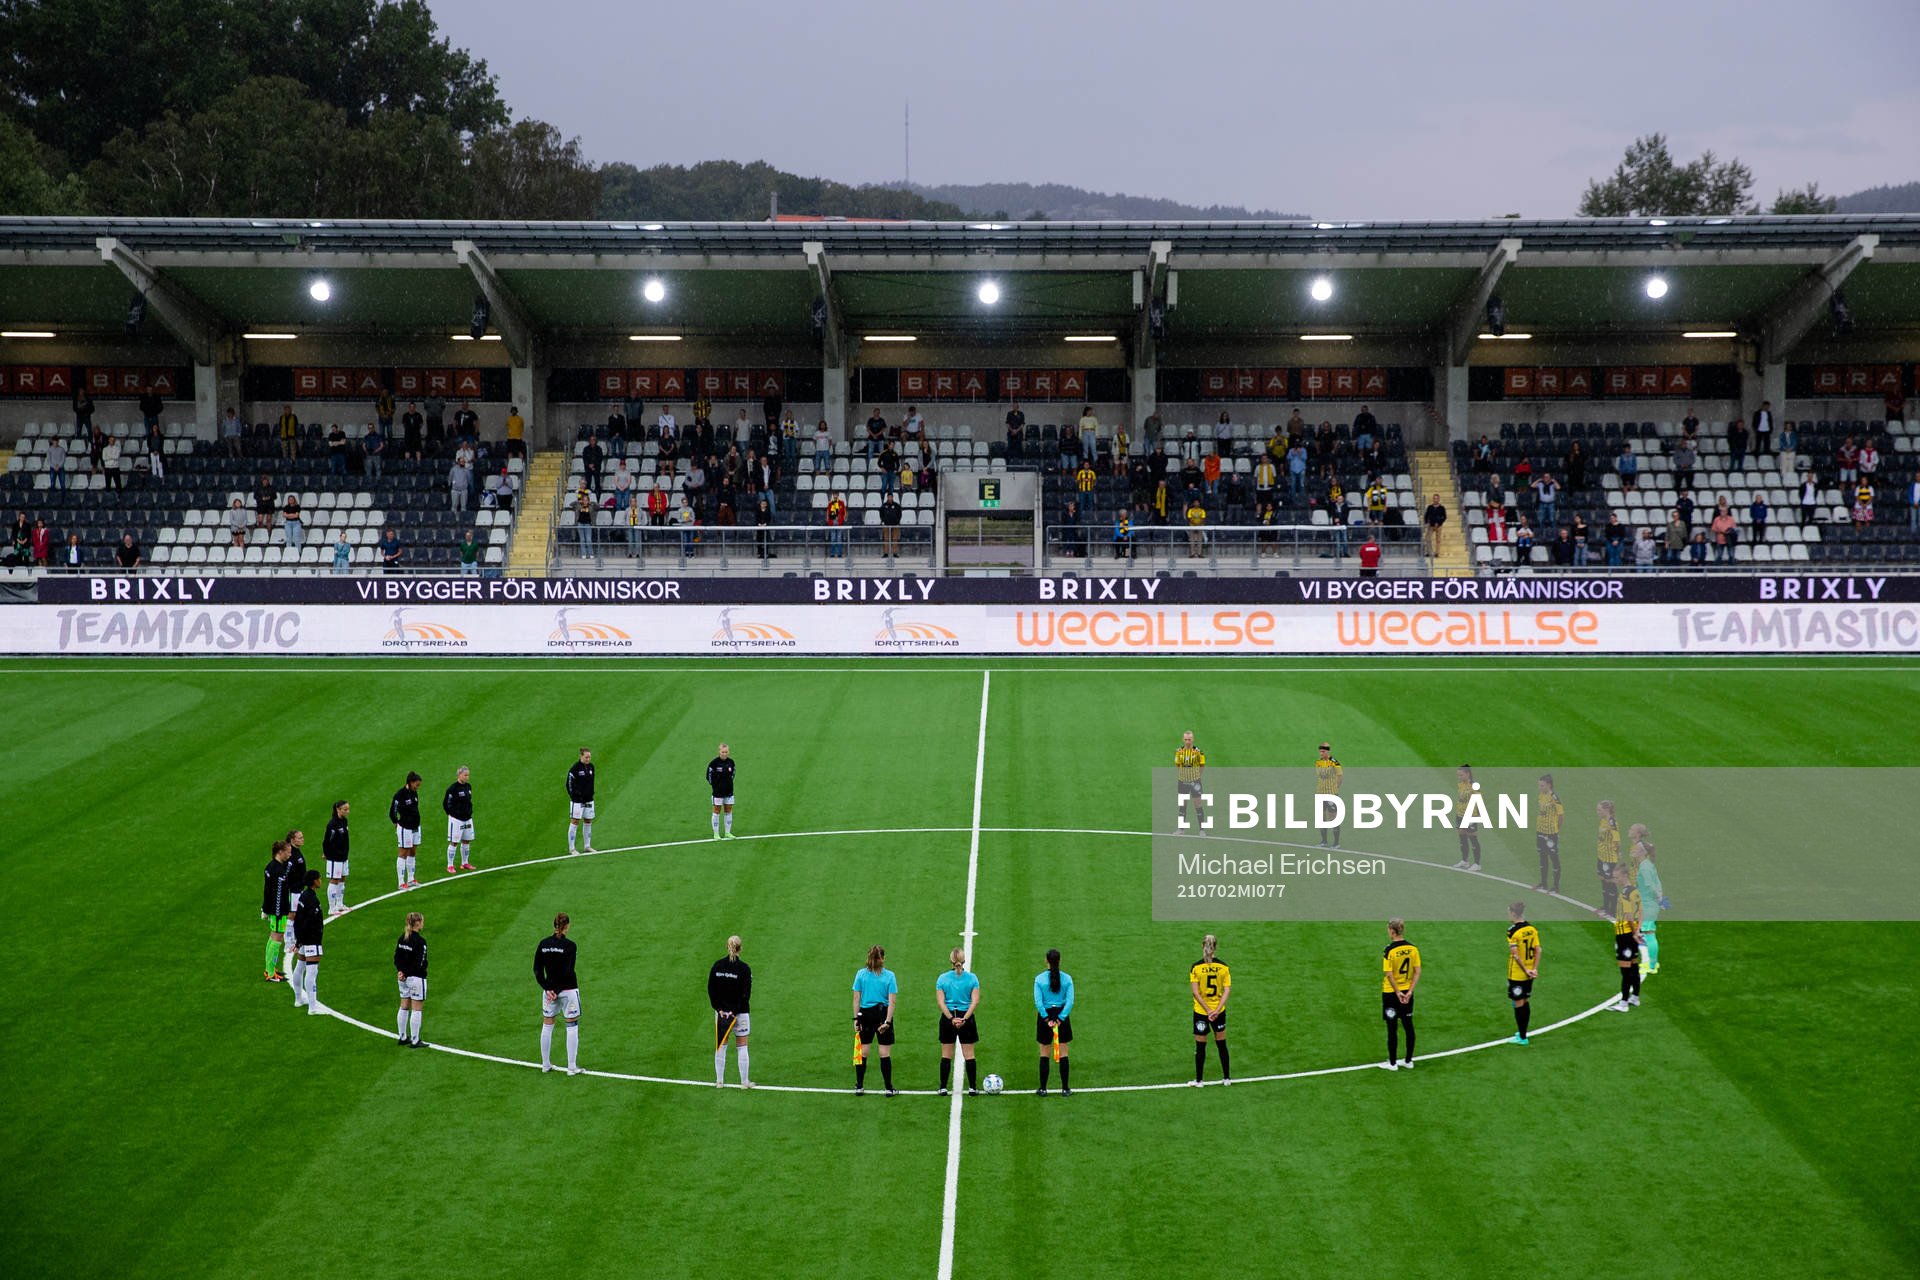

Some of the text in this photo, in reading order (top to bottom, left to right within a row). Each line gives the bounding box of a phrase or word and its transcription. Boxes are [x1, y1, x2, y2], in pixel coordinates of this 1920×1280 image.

[301, 375, 377, 389] BRA
[401, 376, 478, 389] BRA
[606, 376, 681, 390] BRA
[704, 376, 780, 390] BRA
[907, 376, 982, 390] BRA
[1006, 376, 1080, 390] BRA
[1209, 376, 1284, 390] BRA
[1307, 375, 1383, 389] BRA
[1511, 374, 1588, 388] BRA
[1611, 374, 1688, 388] BRA
[1820, 372, 1896, 387] BRA
[984, 485, 995, 499] E
[90, 578, 215, 600] BRIXLY
[356, 577, 681, 600] VI BYGGER FÖR MÄNNISKOR
[814, 579, 935, 601] BRIXLY
[1039, 578, 1160, 600] BRIXLY
[1298, 577, 1624, 600] VI BYGGER FÖR MÄNNISKOR
[1760, 578, 1886, 599] BRIXLY
[57, 607, 301, 650] TEAMTASTIC
[1672, 607, 1918, 649] TEAMTASTIC
[1522, 938, 1535, 960] 16
[1398, 957, 1411, 980] 4
[1206, 974, 1218, 998] 5
